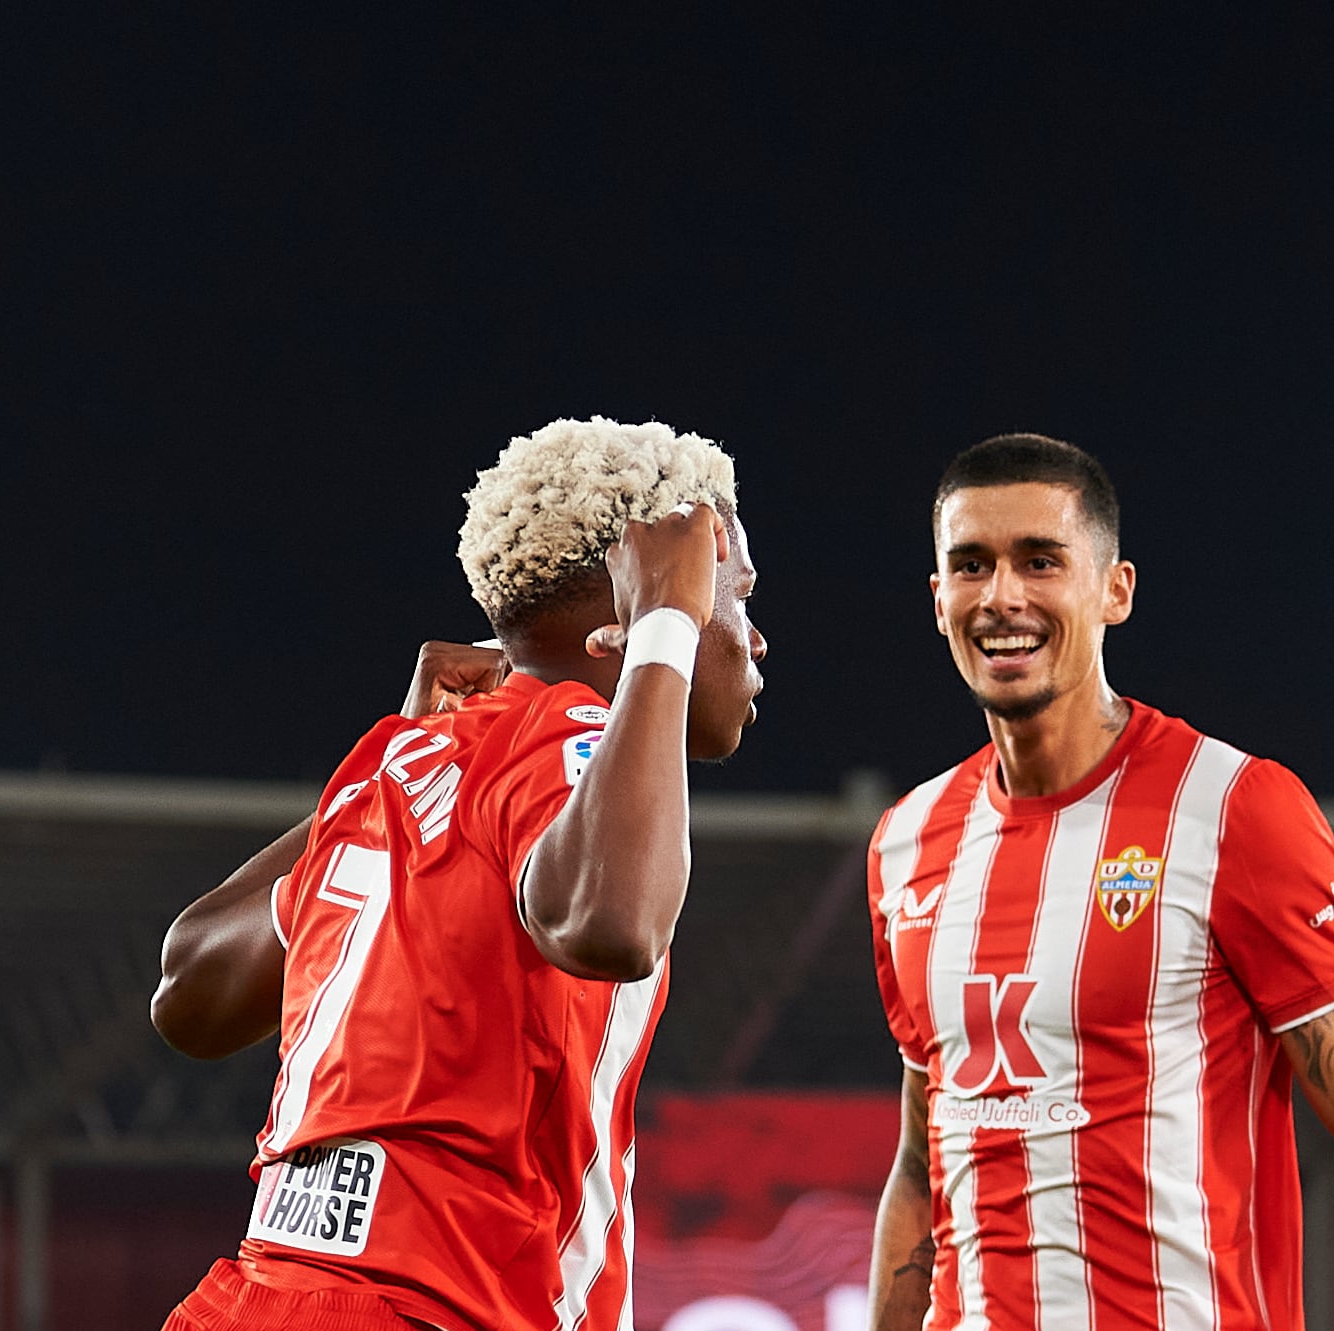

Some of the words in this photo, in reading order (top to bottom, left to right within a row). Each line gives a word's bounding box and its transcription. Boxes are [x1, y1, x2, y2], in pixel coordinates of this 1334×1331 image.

[259, 842, 391, 1161] 7
[984, 1103, 1041, 1122] Juffali
[1048, 1102, 1083, 1122] Co.
[285, 1145, 375, 1197] POWER
[267, 1188, 367, 1244] HORSE
